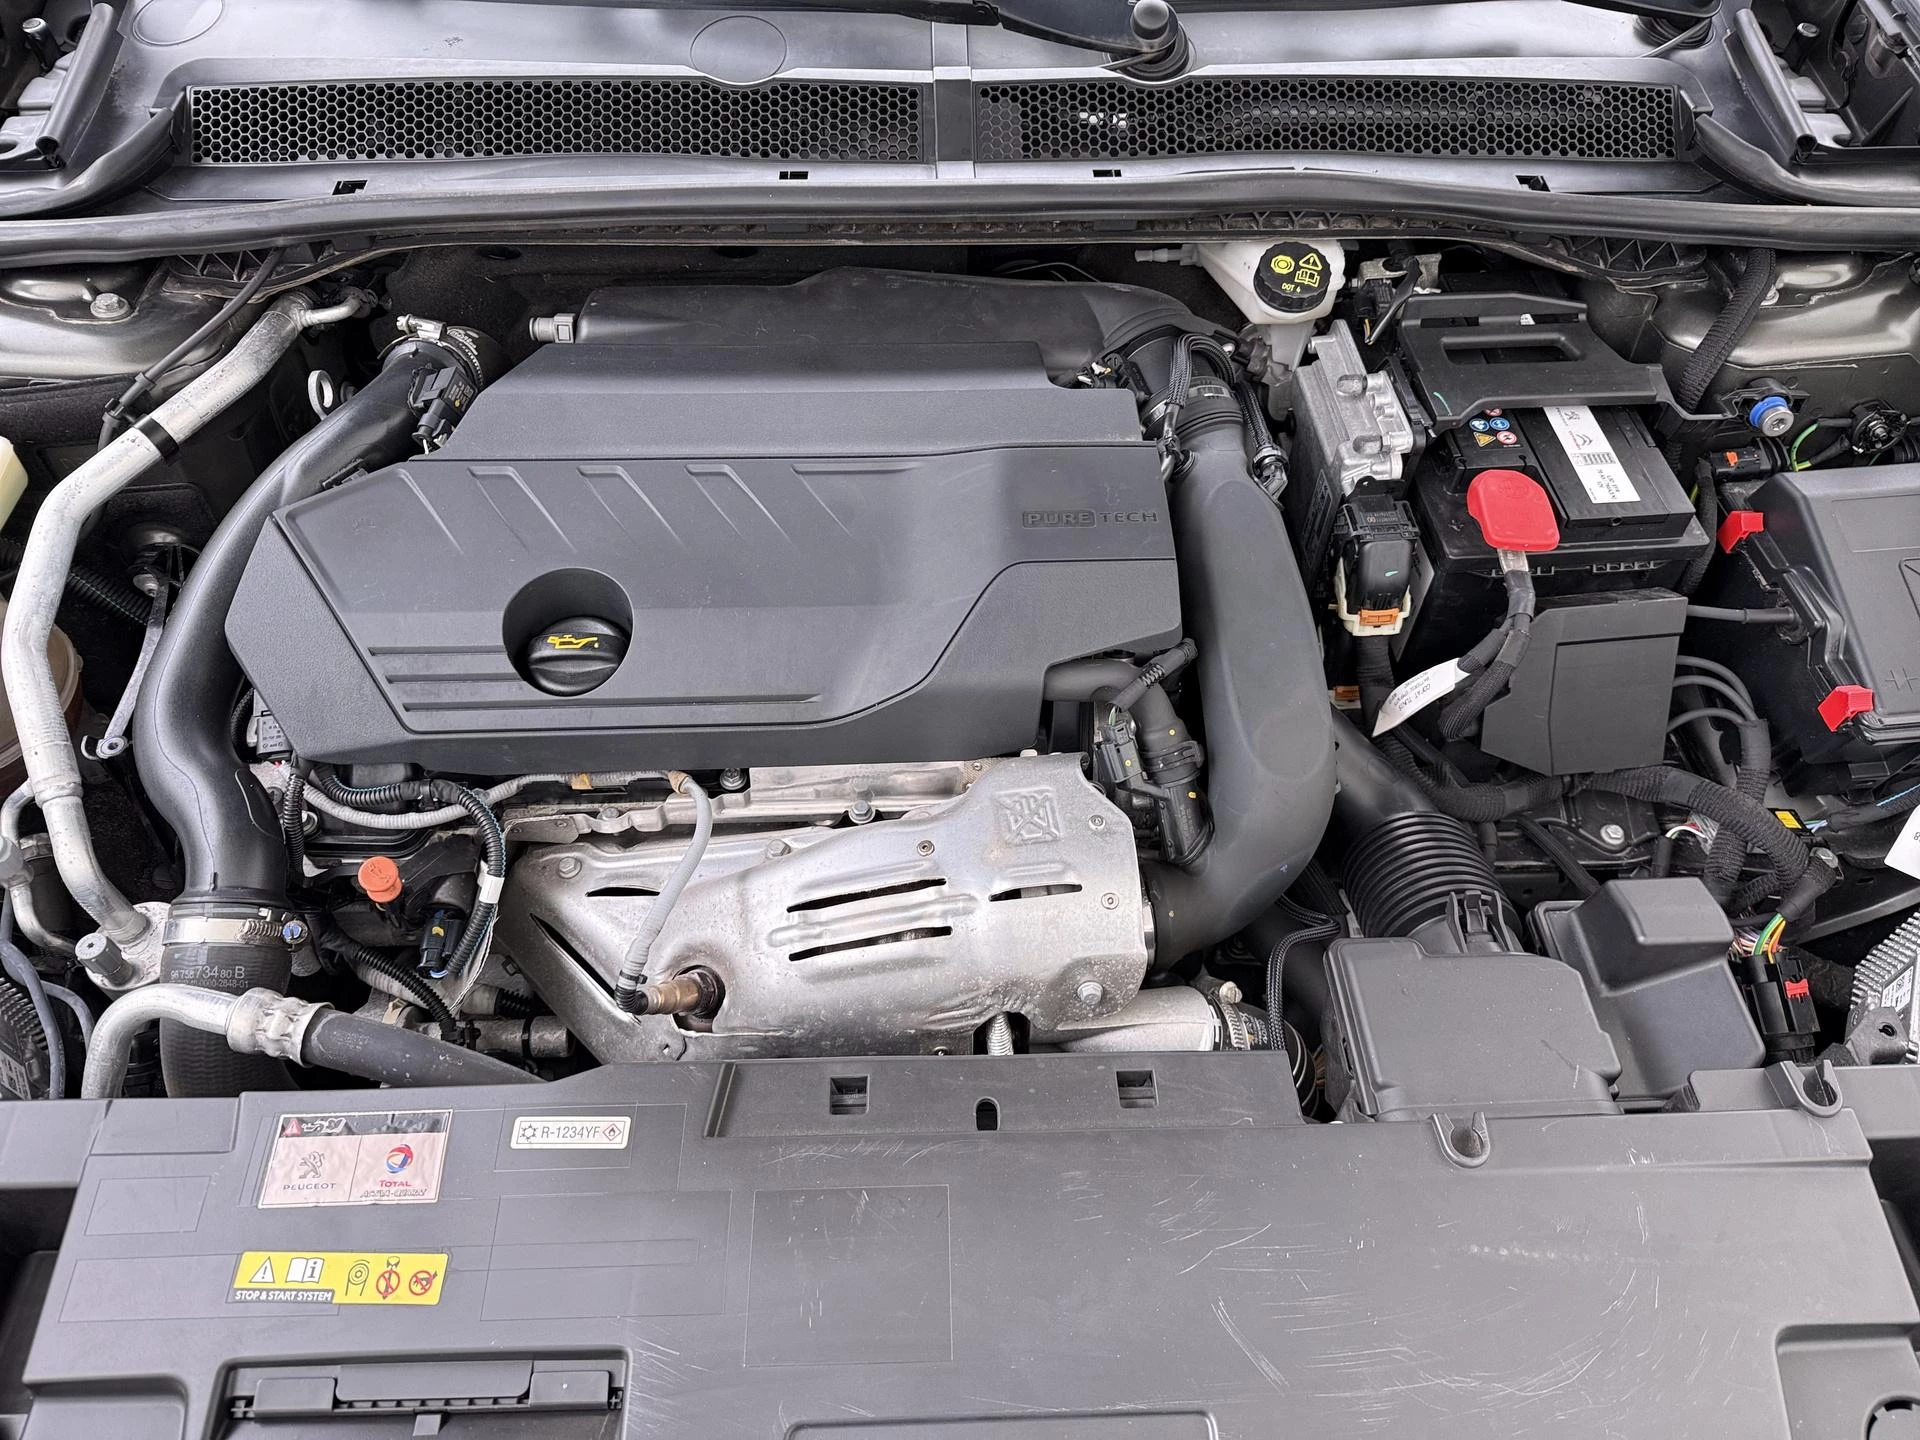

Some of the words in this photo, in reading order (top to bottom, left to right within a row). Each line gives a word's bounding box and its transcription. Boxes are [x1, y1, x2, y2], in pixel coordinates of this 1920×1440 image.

[1282, 282, 1295, 291] DOT
[1028, 512, 1090, 524] PURE
[1100, 511, 1158, 523] TECH
[235, 965, 245, 979] B
[540, 1126, 601, 1139] R-1234YF
[282, 1182, 337, 1191] PEUGEOT
[379, 1180, 412, 1188] TOTAL
[235, 1290, 260, 1300] STOP
[259, 1291, 268, 1300] &
[267, 1291, 297, 1301] START
[296, 1291, 333, 1301] SYSTEM
